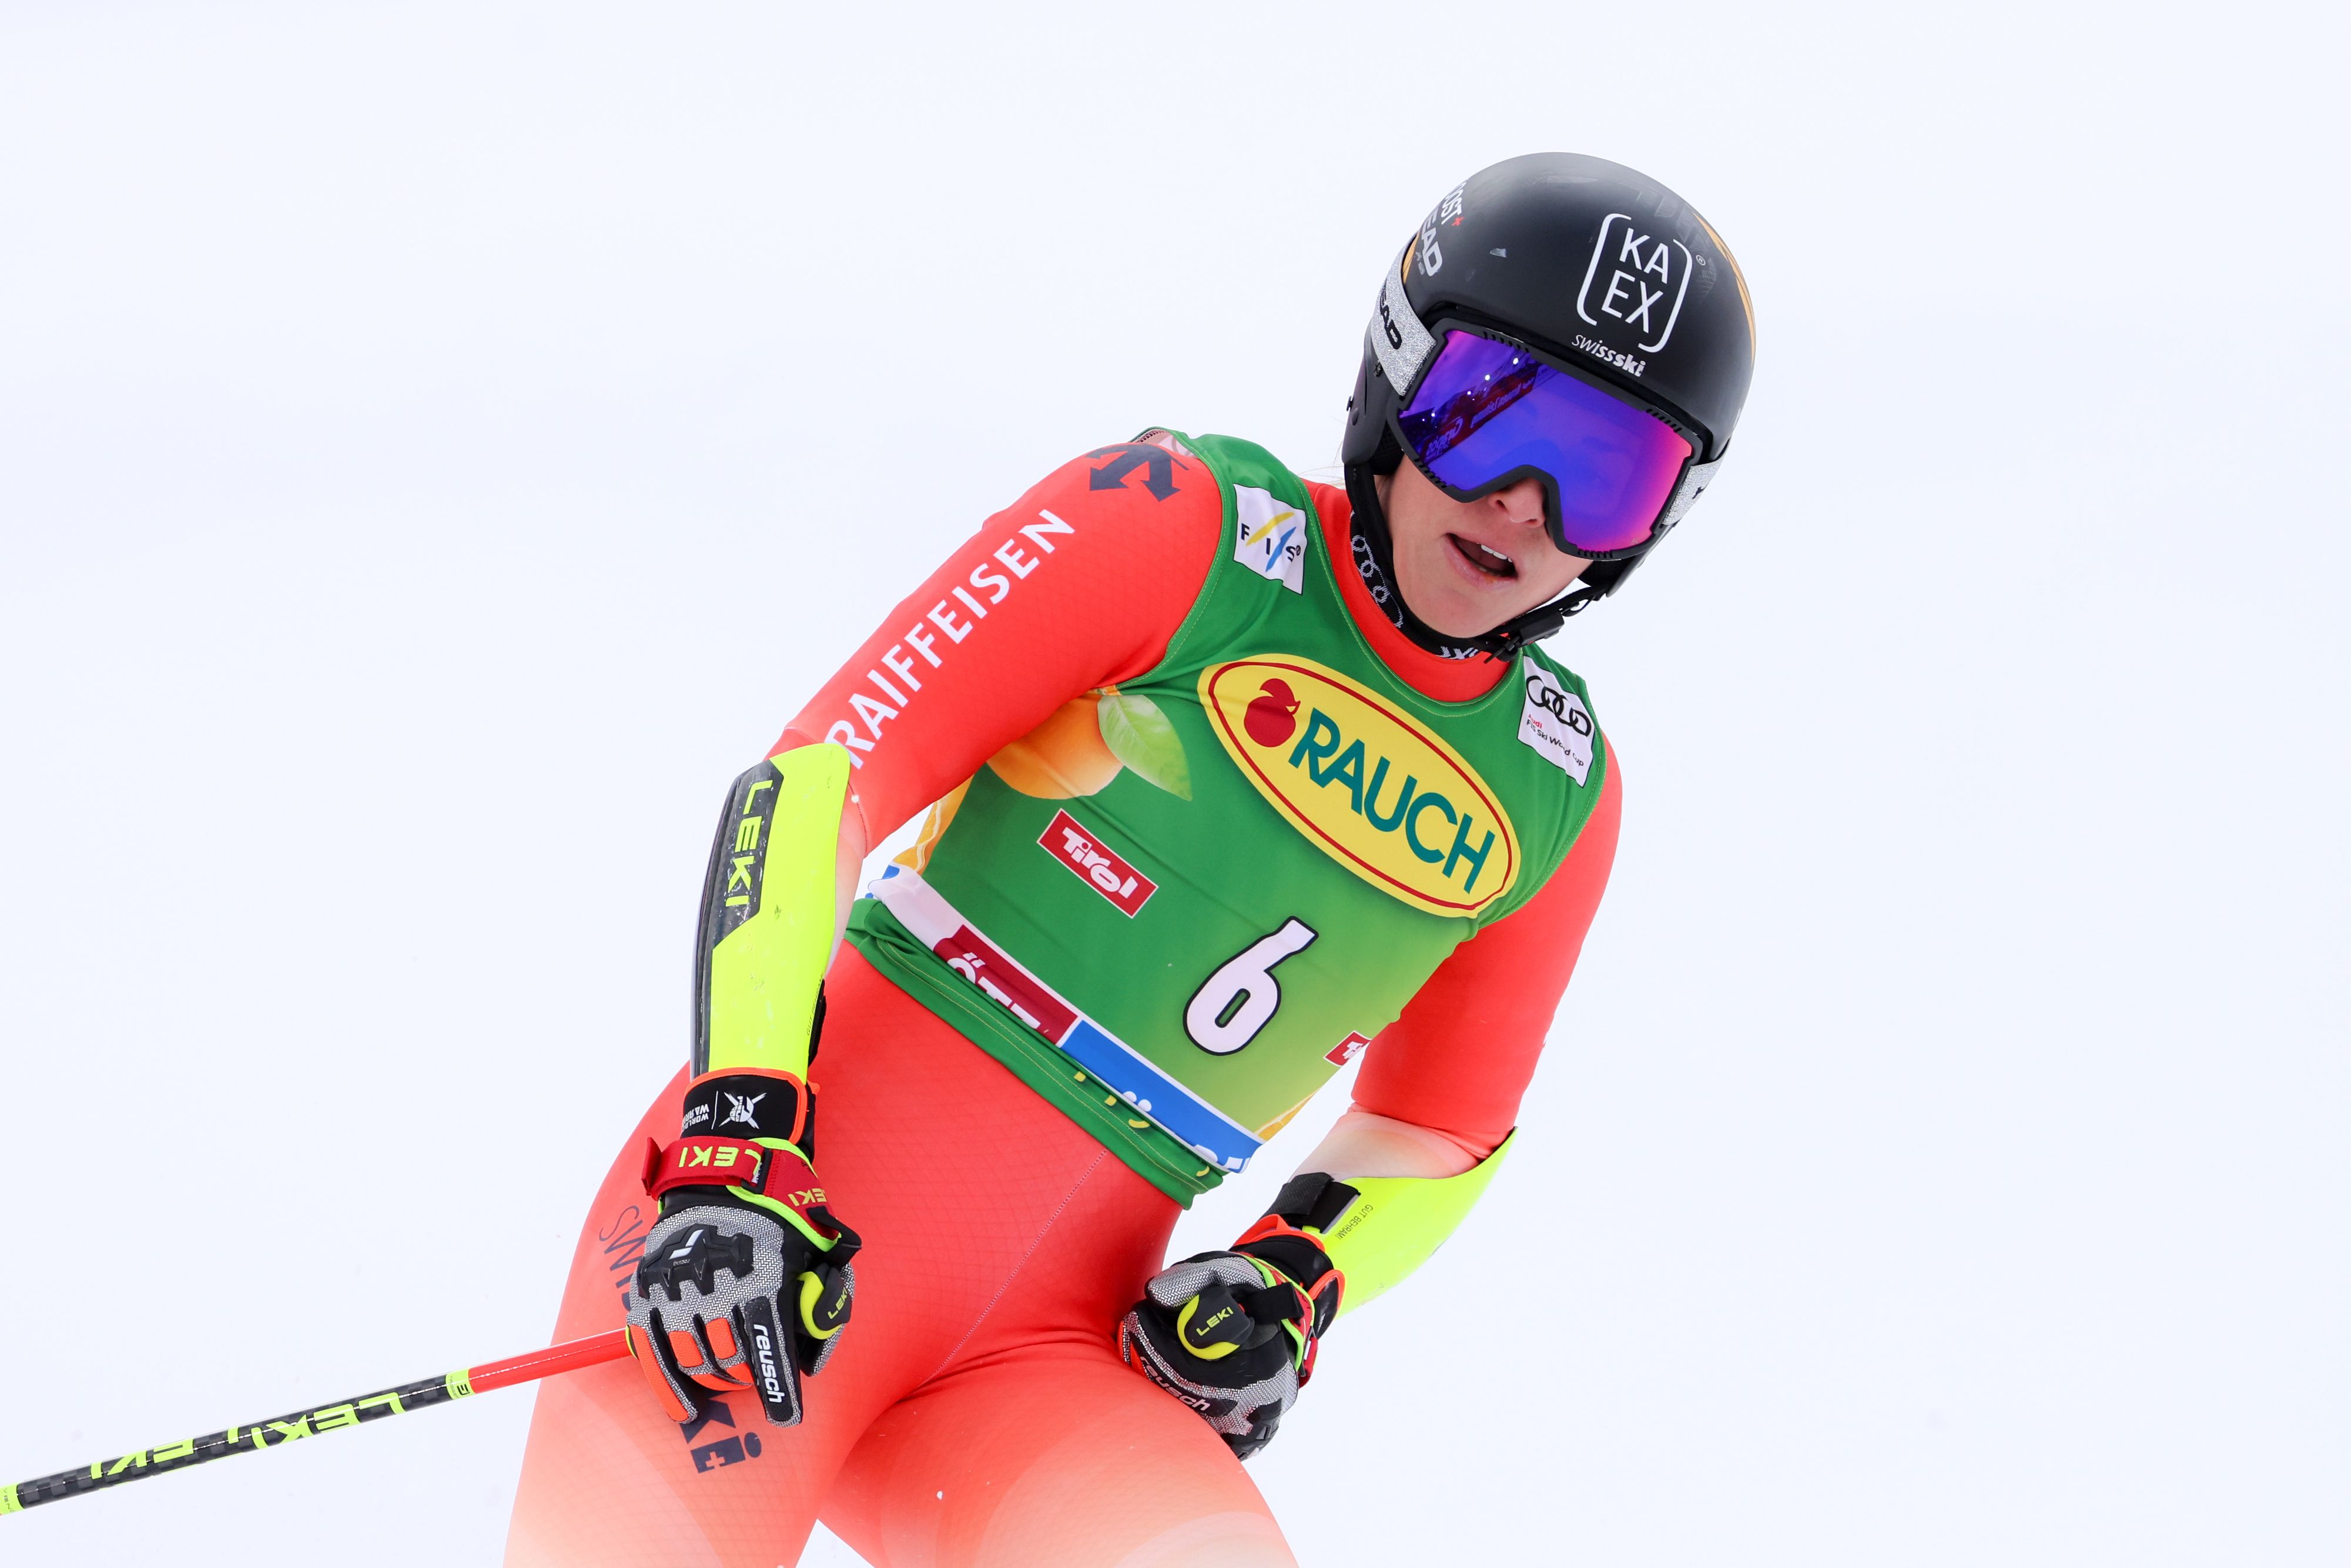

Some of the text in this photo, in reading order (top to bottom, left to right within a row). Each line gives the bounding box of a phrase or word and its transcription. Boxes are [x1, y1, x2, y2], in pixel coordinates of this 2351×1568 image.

[1619, 227, 1669, 284] KA
[1601, 269, 1664, 334] EX
[1572, 334, 1646, 377] swissski
[824, 509, 1076, 770] RAIFFEISEN
[1536, 729, 1548, 741] Ski
[1288, 707, 1496, 894] RAUCH
[725, 779, 773, 907] LEKI
[1061, 826, 1138, 899] Tirol
[1183, 915, 1319, 1057] 6
[678, 1145, 763, 1175] LEKI
[1359, 1204, 1374, 1218] GUT
[1196, 1306, 1234, 1336] LEKI
[753, 1324, 785, 1404] reusch
[1140, 1356, 1211, 1411] reusch
[251, 1391, 406, 1450] LEKI
